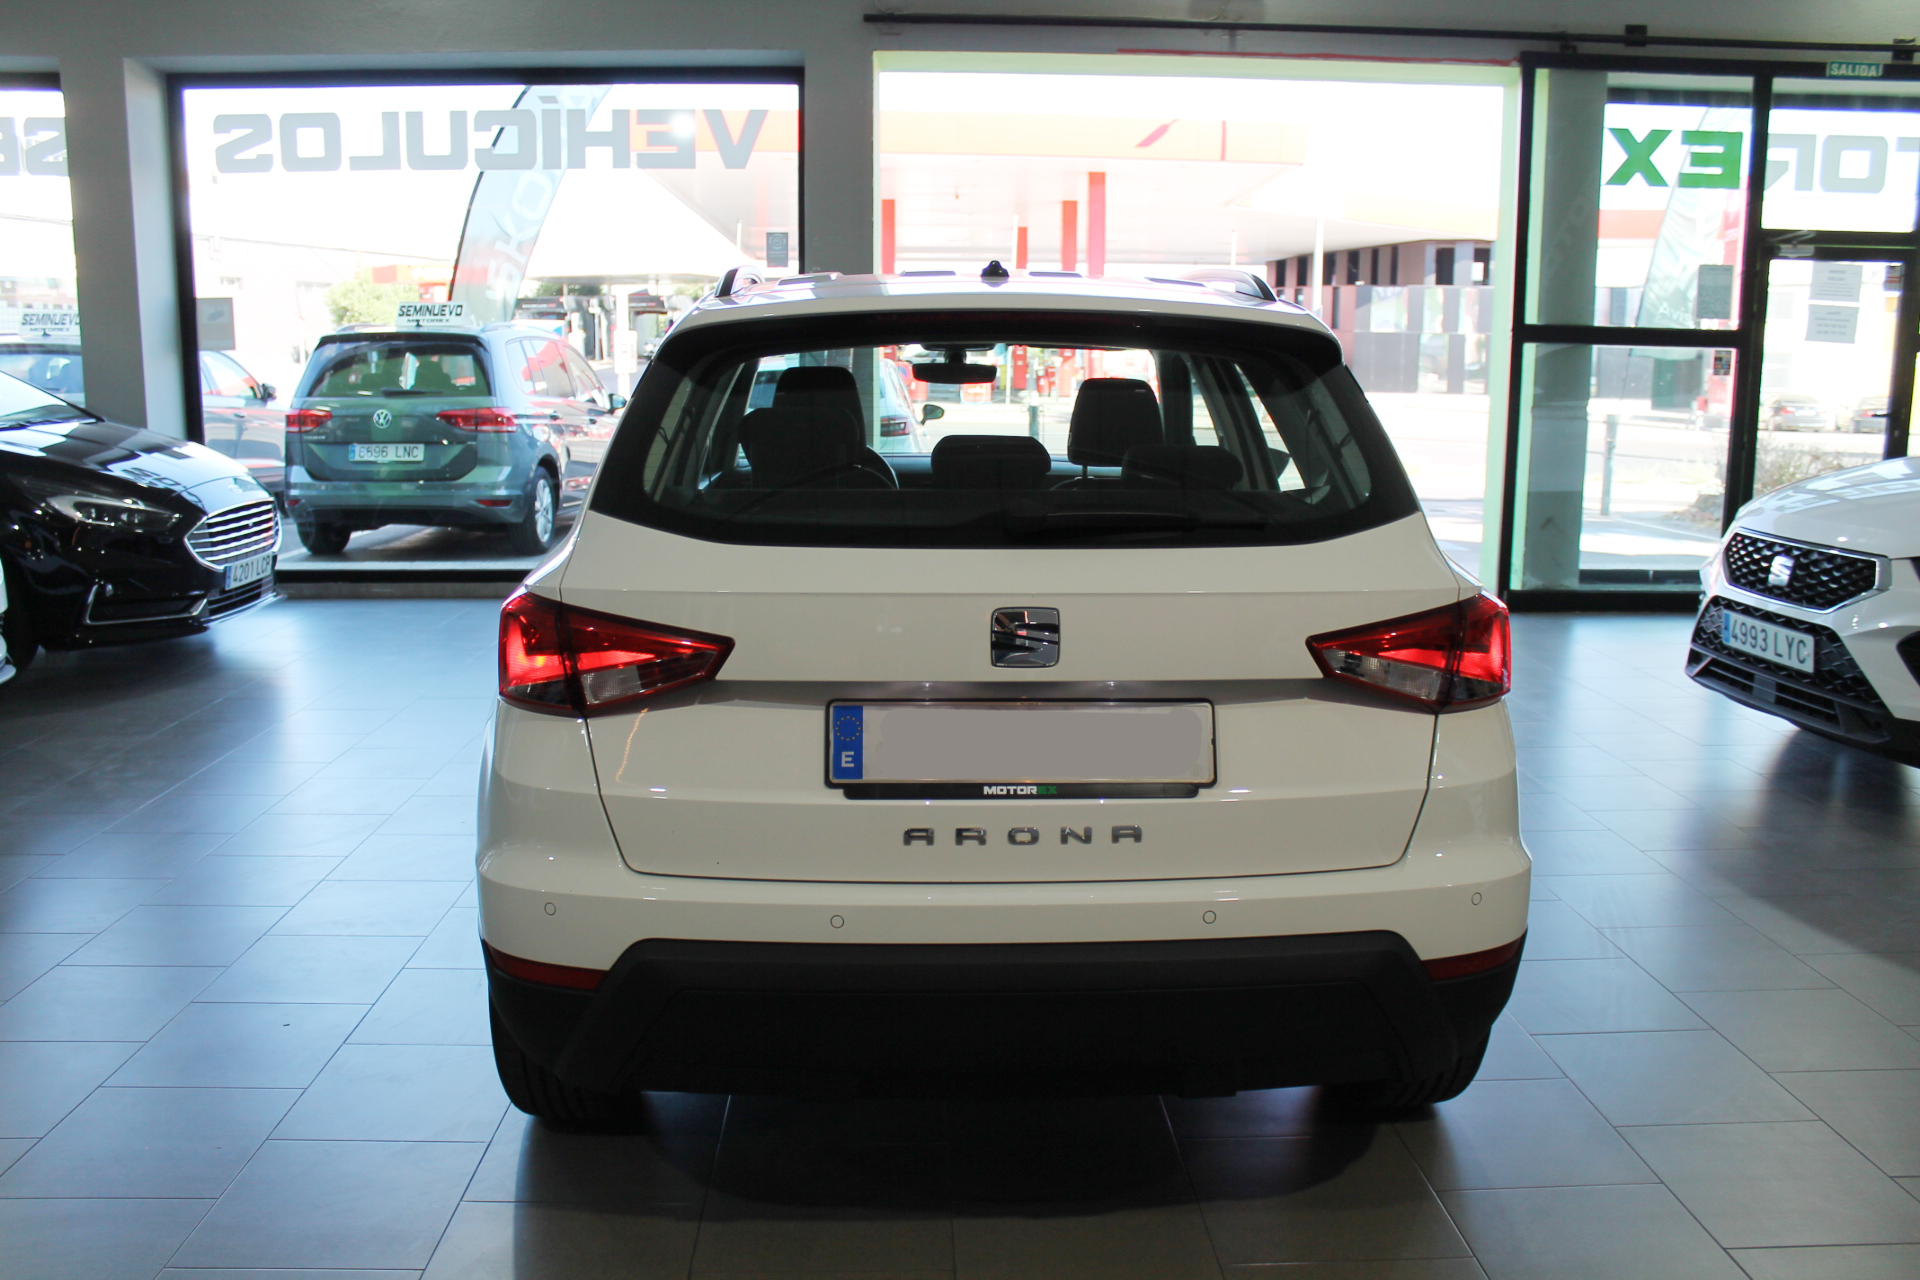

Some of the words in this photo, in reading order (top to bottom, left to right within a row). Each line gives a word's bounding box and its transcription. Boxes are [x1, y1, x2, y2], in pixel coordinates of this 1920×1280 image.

[1830, 63, 1877, 77] SALIDA
[398, 304, 463, 317] SEMINUEVO
[395, 445, 419, 459] LNC
[233, 561, 254, 582] 4201
[1731, 620, 1767, 652] 4993
[1774, 632, 1806, 664] LYC
[841, 751, 855, 767] E
[983, 785, 1057, 795] MOTOREX
[903, 825, 1143, 846] ARONA
